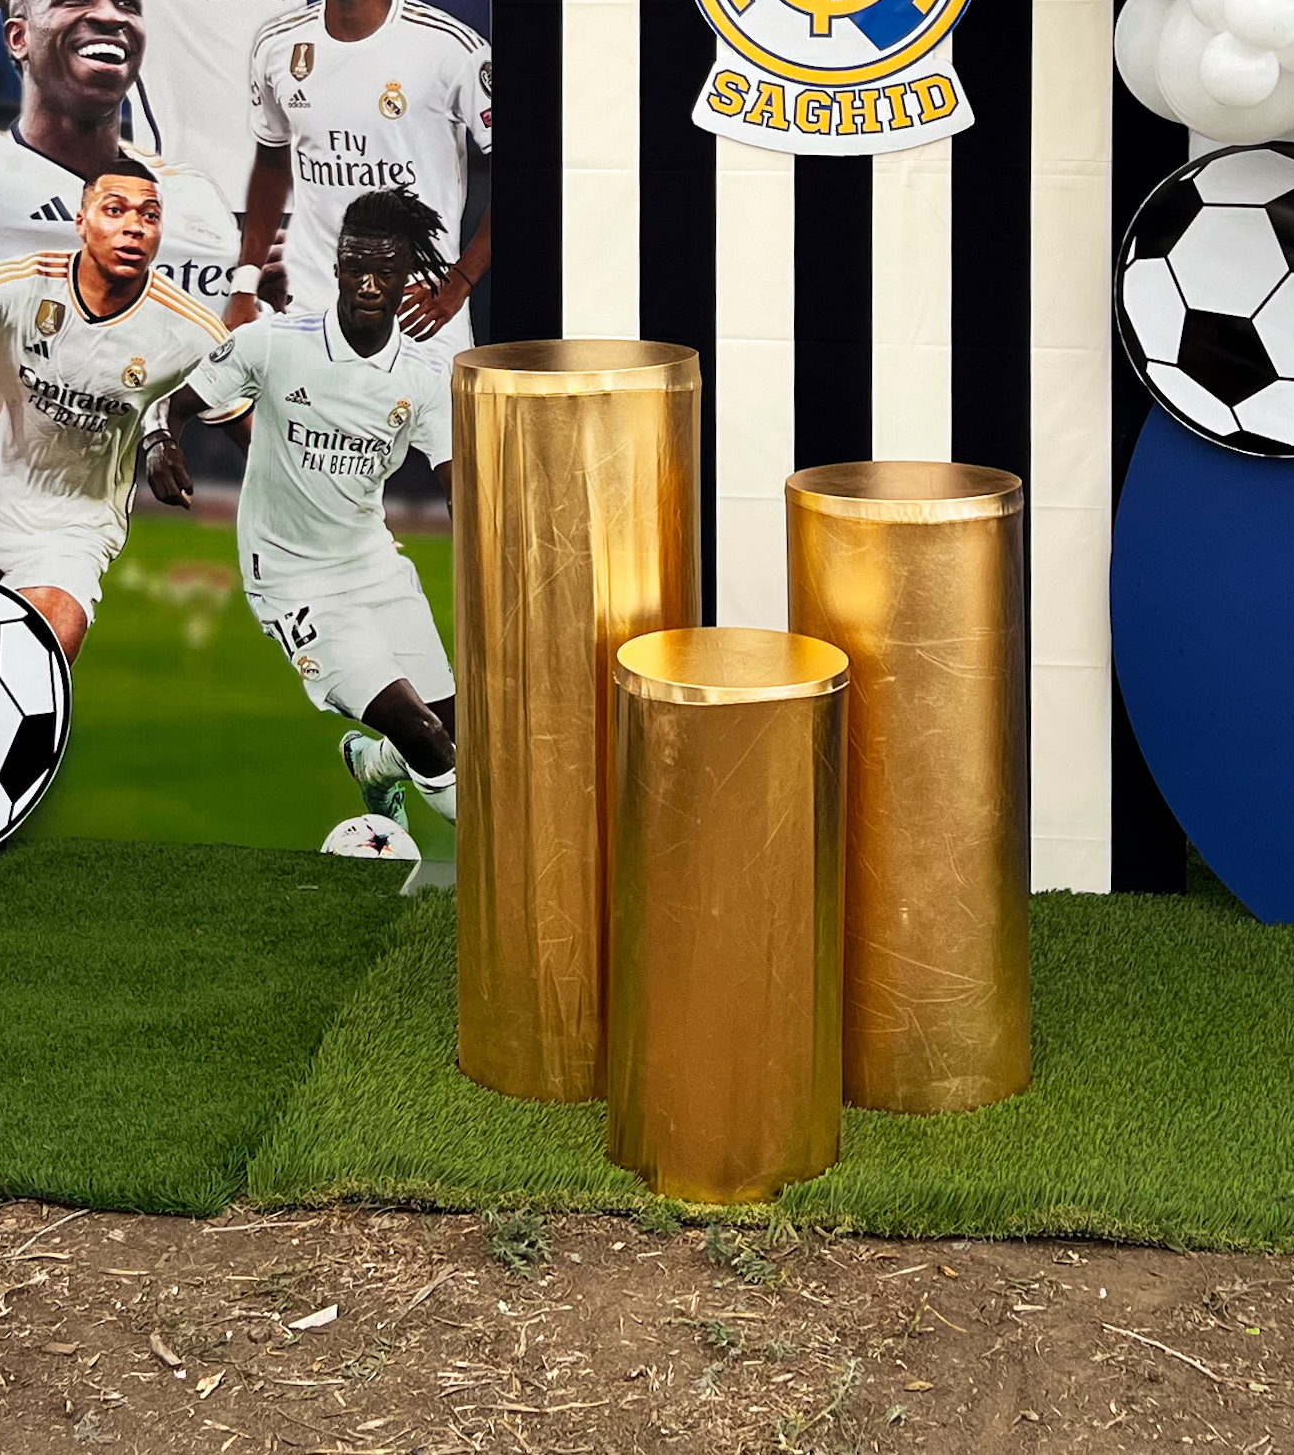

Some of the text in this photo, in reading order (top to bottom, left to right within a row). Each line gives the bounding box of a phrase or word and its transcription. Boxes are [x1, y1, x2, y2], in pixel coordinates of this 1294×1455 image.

[706, 69, 959, 136] SAGHID
[329, 130, 367, 156] Fly
[297, 154, 416, 187] Emirates
[19, 364, 132, 416] Emirates
[28, 394, 108, 433] FLY BETTER
[287, 419, 393, 456] Emirates
[301, 451, 375, 475] FLY BETTER
